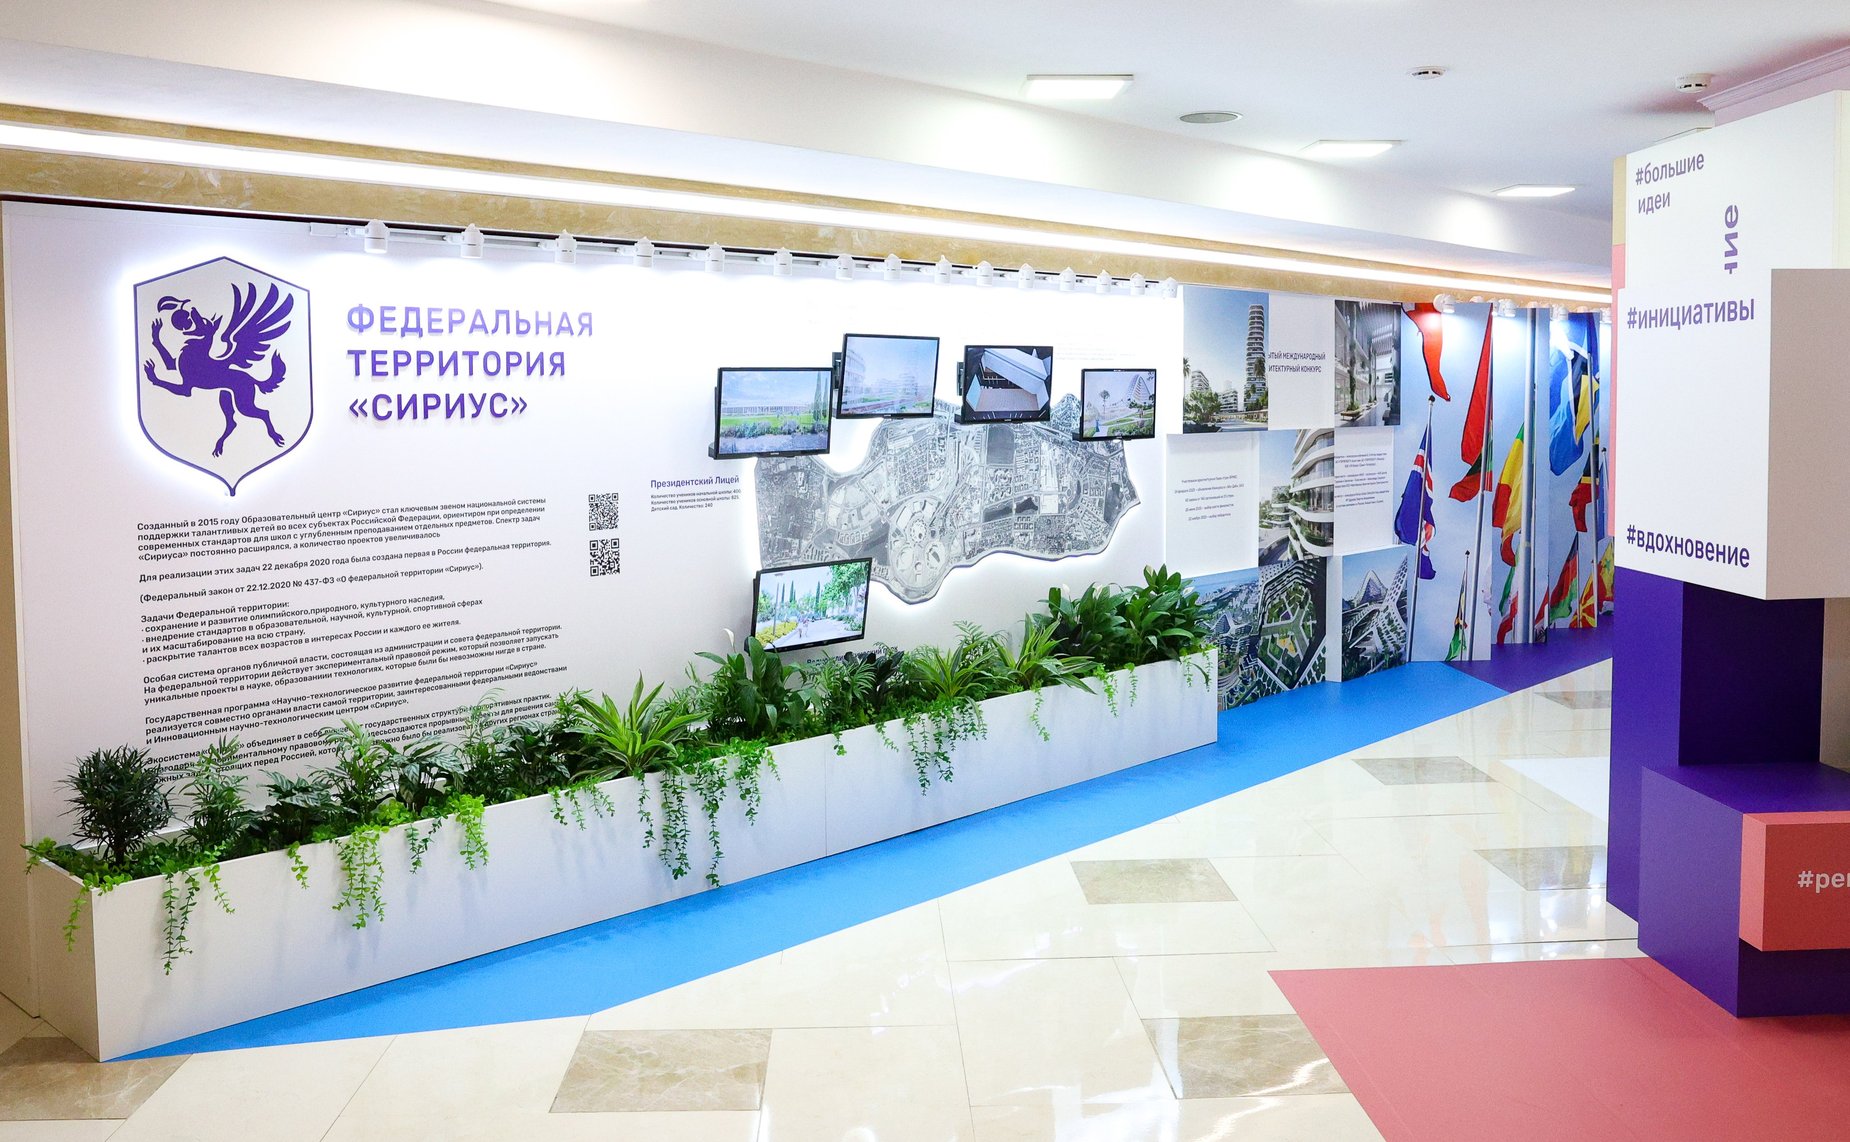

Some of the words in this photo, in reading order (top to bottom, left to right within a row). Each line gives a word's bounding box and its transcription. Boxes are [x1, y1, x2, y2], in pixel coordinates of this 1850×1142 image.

[1635, 152, 1705, 186] #большие
[1638, 191, 1671, 215] идеи
[347, 303, 593, 338] ФЕДЕРАЛЬНАЯ
[1627, 298, 1755, 331] #инициативы
[347, 349, 566, 377] ТЕРРИТОРИЯ
[348, 392, 528, 421] «СИРИУС»
[650, 477, 714, 490] Президентский
[714, 475, 740, 485] Лицей
[137, 519, 189, 530] Созданный
[197, 517, 219, 526] 2015
[241, 511, 316, 524] Образовательный
[317, 511, 341, 521] центр
[342, 508, 380, 519] «Сириус»
[466, 498, 516, 508] национальной
[137, 531, 189, 540] поддержки
[191, 527, 248, 536] талантливых
[249, 523, 275, 533] детей
[308, 517, 349, 530] субъектах
[350, 515, 396, 525] Российской
[442, 511, 485, 519] ориентиром
[486, 510, 500, 518] при
[137, 541, 200, 551] современных
[201, 536, 252, 546] стандартов
[299, 529, 352, 540] углубленным
[353, 525, 413, 535] преподаванием
[495, 514, 520, 524] Спектр
[138, 551, 188, 561] «Сириуса»
[190, 548, 237, 557] постоянно
[299, 539, 346, 548] количество
[347, 536, 383, 545] проектов
[384, 532, 440, 542] увеличивалось
[1627, 524, 1750, 568] #вдохновение
[138, 574, 157, 583] Для
[158, 570, 212, 581] реализации
[262, 562, 272, 570] 22
[273, 560, 308, 570] декабря
[309, 558, 330, 566] 2020
[464, 544, 510, 553] федеральная
[139, 588, 207, 603] (Федеральный
[246, 580, 291, 591] 22.12.2020
[303, 576, 335, 585] 437-ФЗ
[347, 570, 399, 582] федеральной
[400, 568, 444, 577] территории
[140, 614, 174, 622] Задачи
[175, 605, 236, 618] Федеральной
[145, 631, 194, 642] внедрение
[196, 625, 247, 640] стандартов
[412, 600, 456, 612] спортивной
[456, 599, 482, 607] сферах
[143, 673, 176, 683] Особая
[177, 669, 215, 679] система
[216, 664, 252, 675] органов
[252, 656, 298, 670] публичной
[330, 648, 372, 659] состоящая
[384, 640, 442, 654] администрации
[449, 635, 474, 643] совета
[474, 628, 520, 642] федеральной
[146, 651, 196, 664] раскрытие
[196, 646, 238, 656] талантов
[260, 638, 303, 648] возрастов
[310, 632, 352, 642] интересах
[353, 629, 382, 637] России
[389, 624, 421, 632] каждого
[162, 636, 243, 650] масштабирование
[157, 677, 218, 693] федеральной
[218, 672, 270, 683] территории
[270, 665, 313, 678] действует
[314, 653, 394, 670] экспериментальный
[395, 648, 430, 660] правовой
[458, 640, 489, 651] который
[489, 637, 525, 646] позволяет
[525, 633, 559, 642] запускать
[145, 707, 222, 724] Государственная
[223, 700, 270, 713] программа
[271, 685, 377, 704] «Научно-технологическое
[378, 679, 413, 691] развитие
[413, 671, 462, 685] федеральной
[463, 666, 504, 679] территории
[505, 661, 538, 670] «Сириус»
[1797, 870, 1850, 894] #ре
